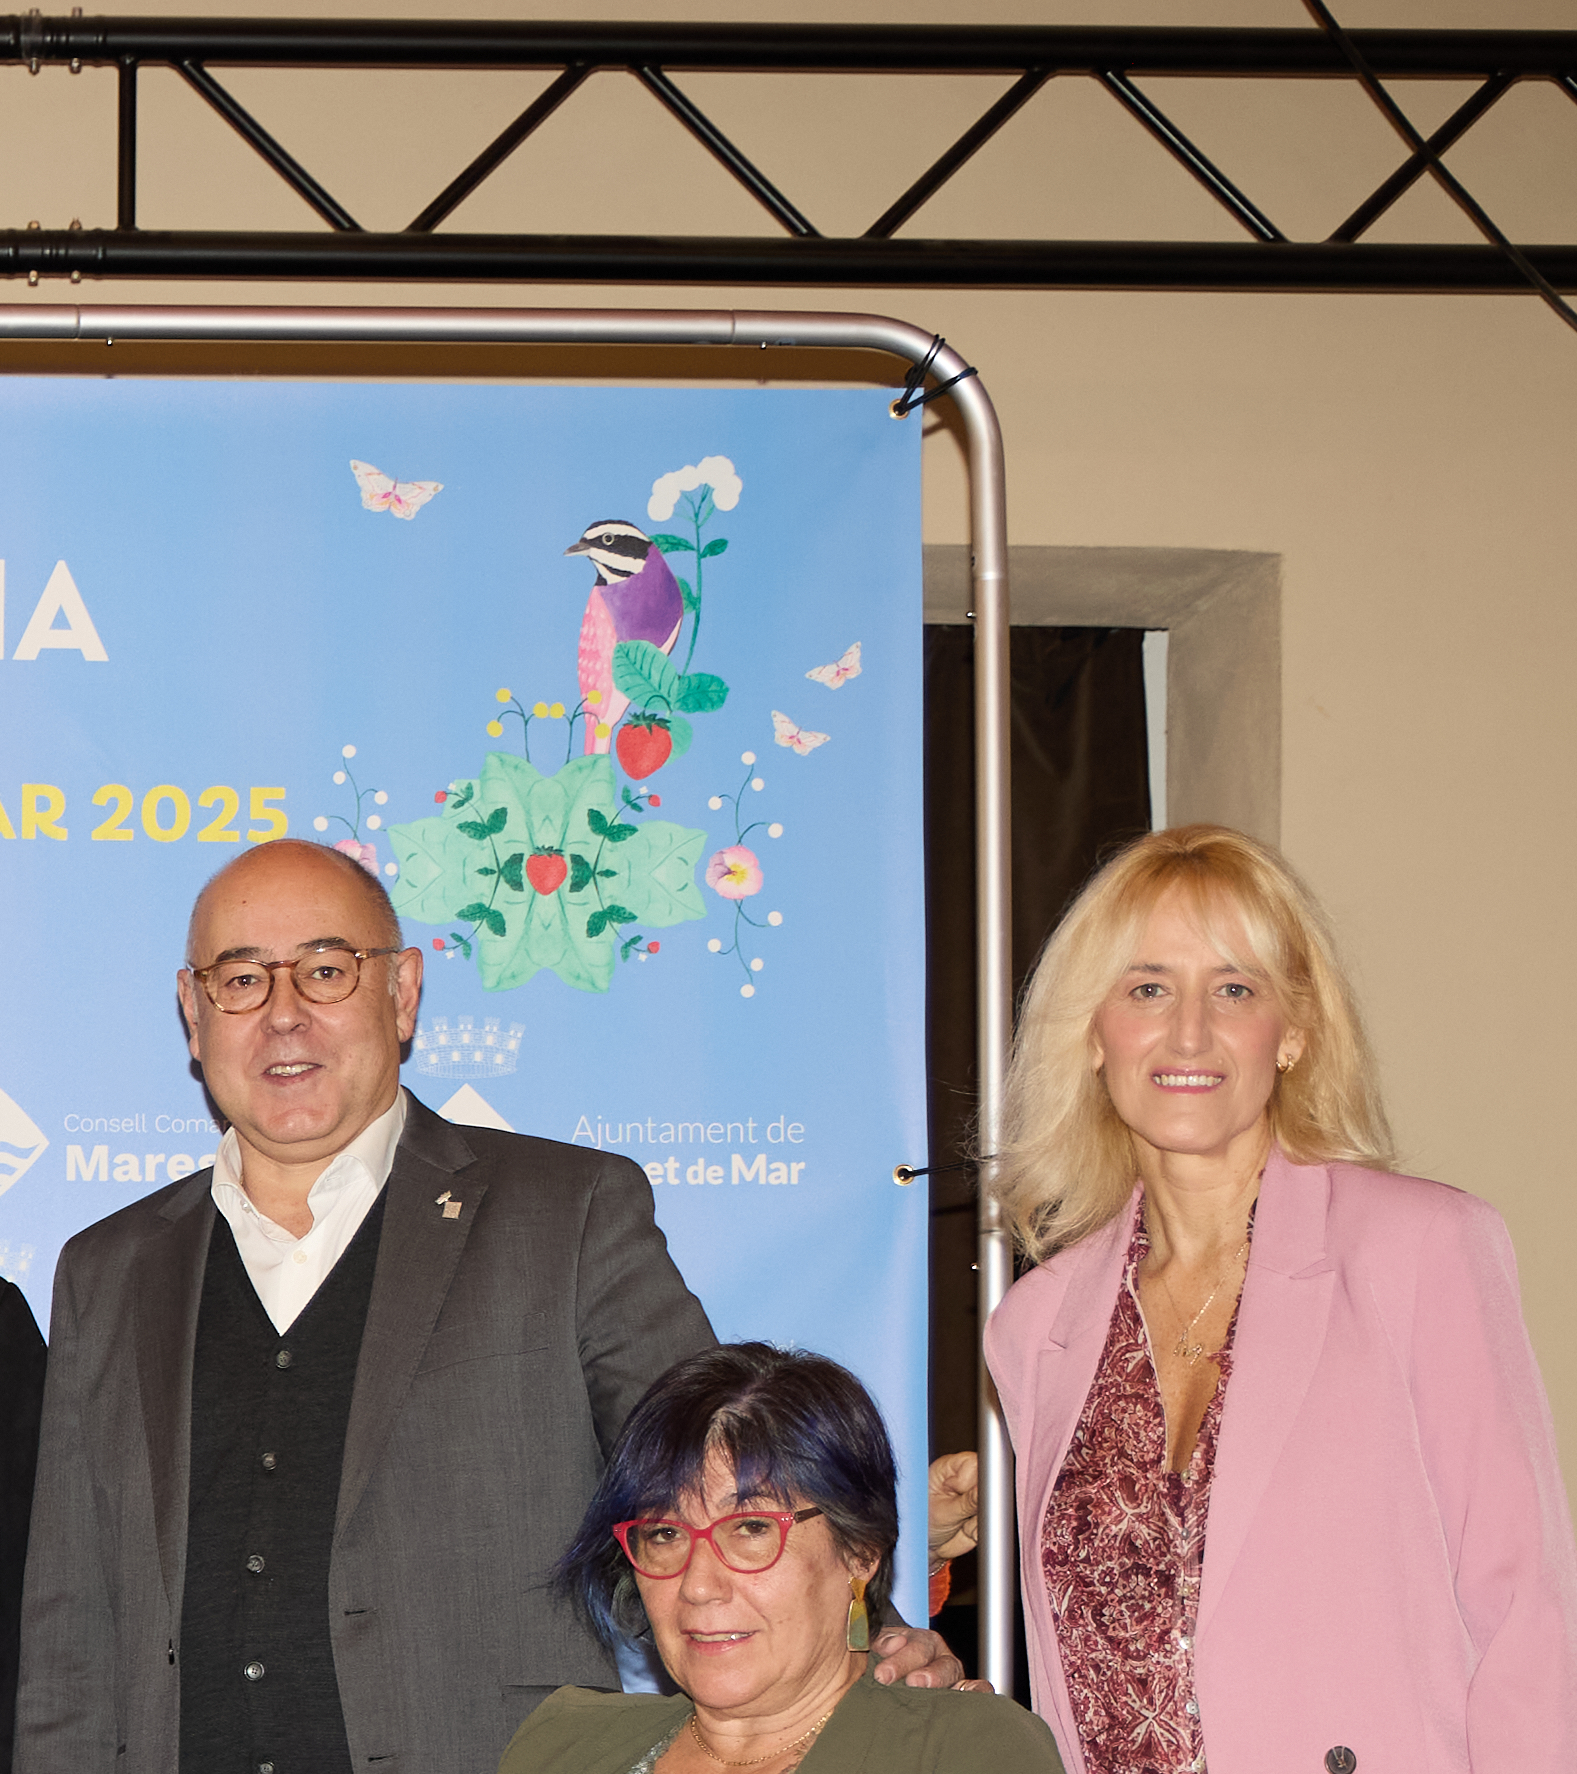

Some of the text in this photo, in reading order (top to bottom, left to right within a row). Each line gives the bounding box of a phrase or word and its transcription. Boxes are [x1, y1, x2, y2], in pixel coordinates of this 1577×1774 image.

[92, 783, 288, 845] 2025
[64, 1113, 230, 1134] Consell Coma
[571, 1115, 805, 1150] Ajuntament de
[66, 1144, 217, 1182] Mares
[686, 1158, 724, 1185] de
[731, 1154, 806, 1185] Mar
